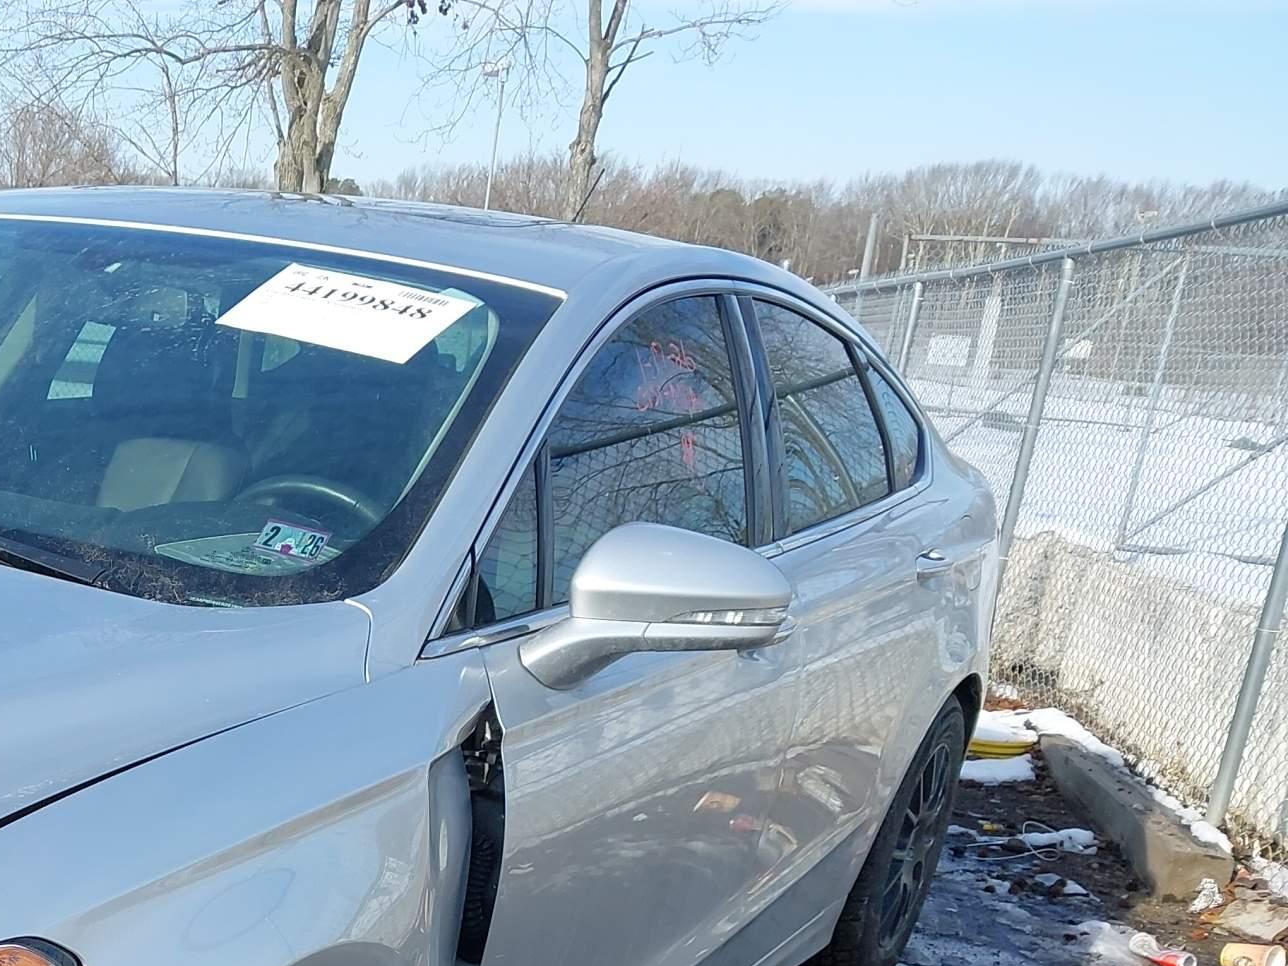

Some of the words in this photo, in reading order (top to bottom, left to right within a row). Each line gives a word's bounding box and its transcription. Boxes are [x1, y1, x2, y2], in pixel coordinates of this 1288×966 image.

[284, 281, 433, 319] 44199848
[262, 525, 282, 547] 2
[300, 534, 325, 557] 26
